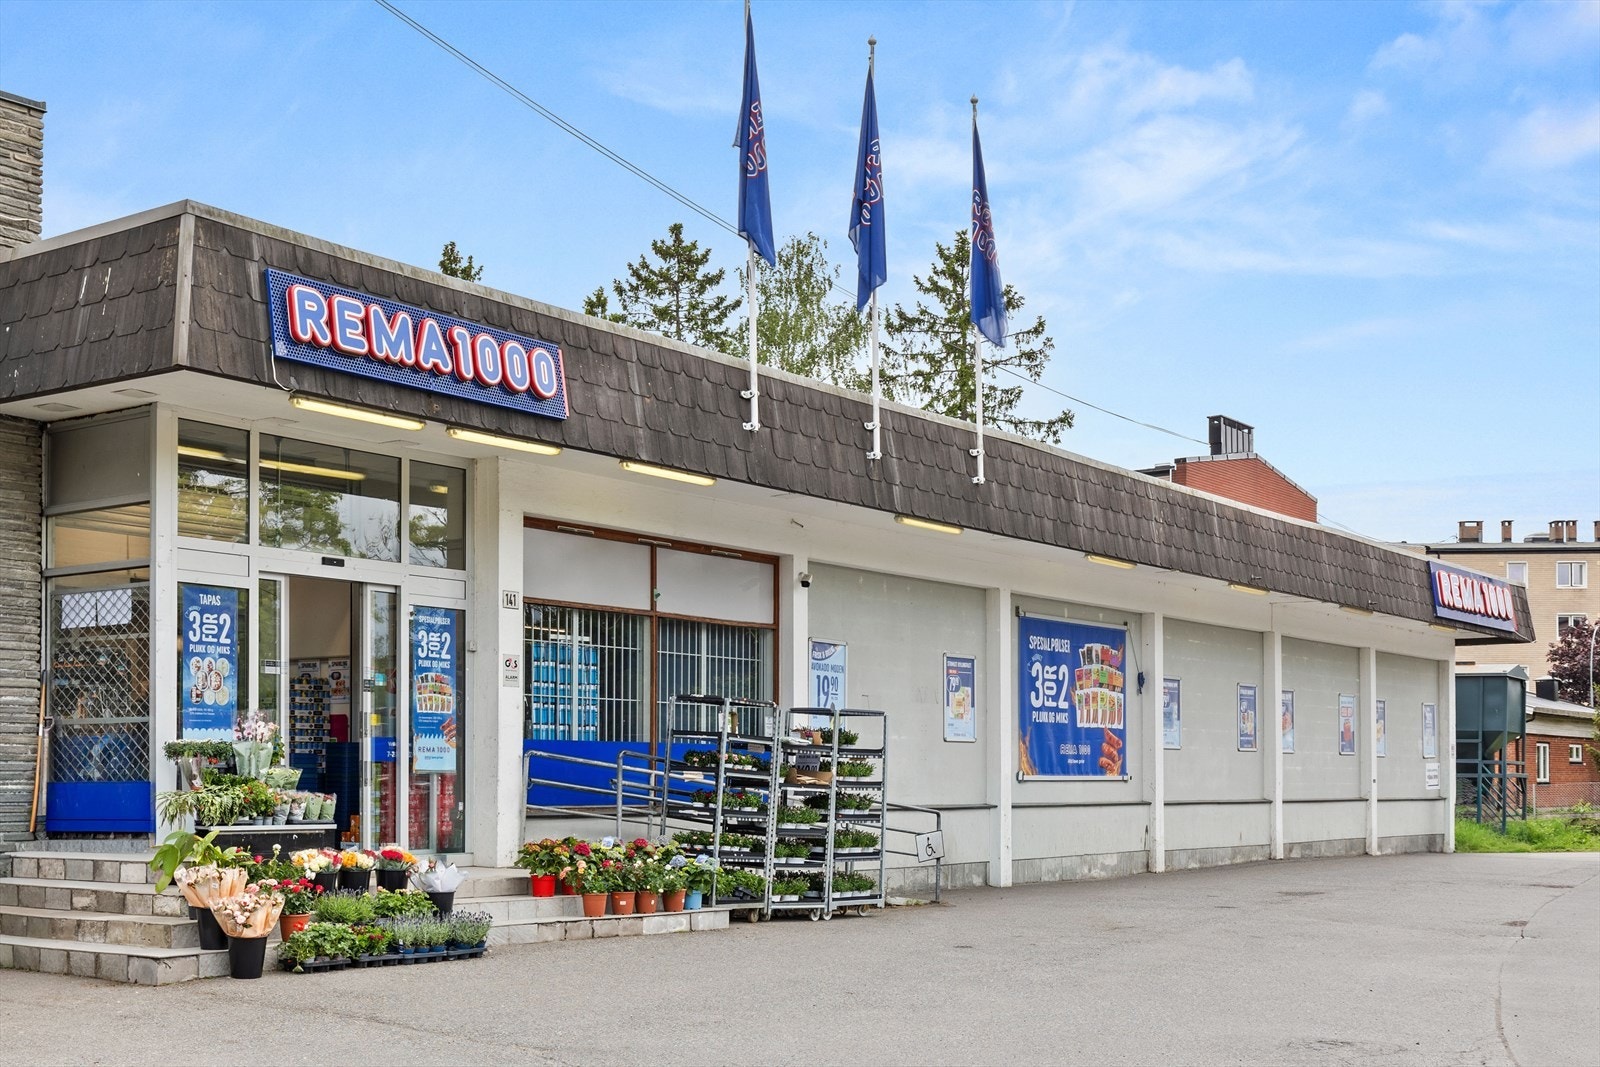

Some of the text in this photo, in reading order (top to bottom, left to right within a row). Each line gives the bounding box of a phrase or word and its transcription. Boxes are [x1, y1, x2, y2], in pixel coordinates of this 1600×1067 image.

[199, 594, 221, 606] TAPAS
[505, 593, 516, 606] 141
[188, 610, 231, 644] 3 FOR 2
[189, 644, 230, 654] PLUKK OG MIKS
[418, 630, 451, 659] 3 FOR 2
[418, 660, 431, 668] PLUKK
[811, 662, 829, 672] AVOKADO
[816, 675, 838, 707] 19 90
[1030, 661, 1069, 709] 3 FOR 2
[1032, 710, 1068, 724] PLUKK OG MIKS
